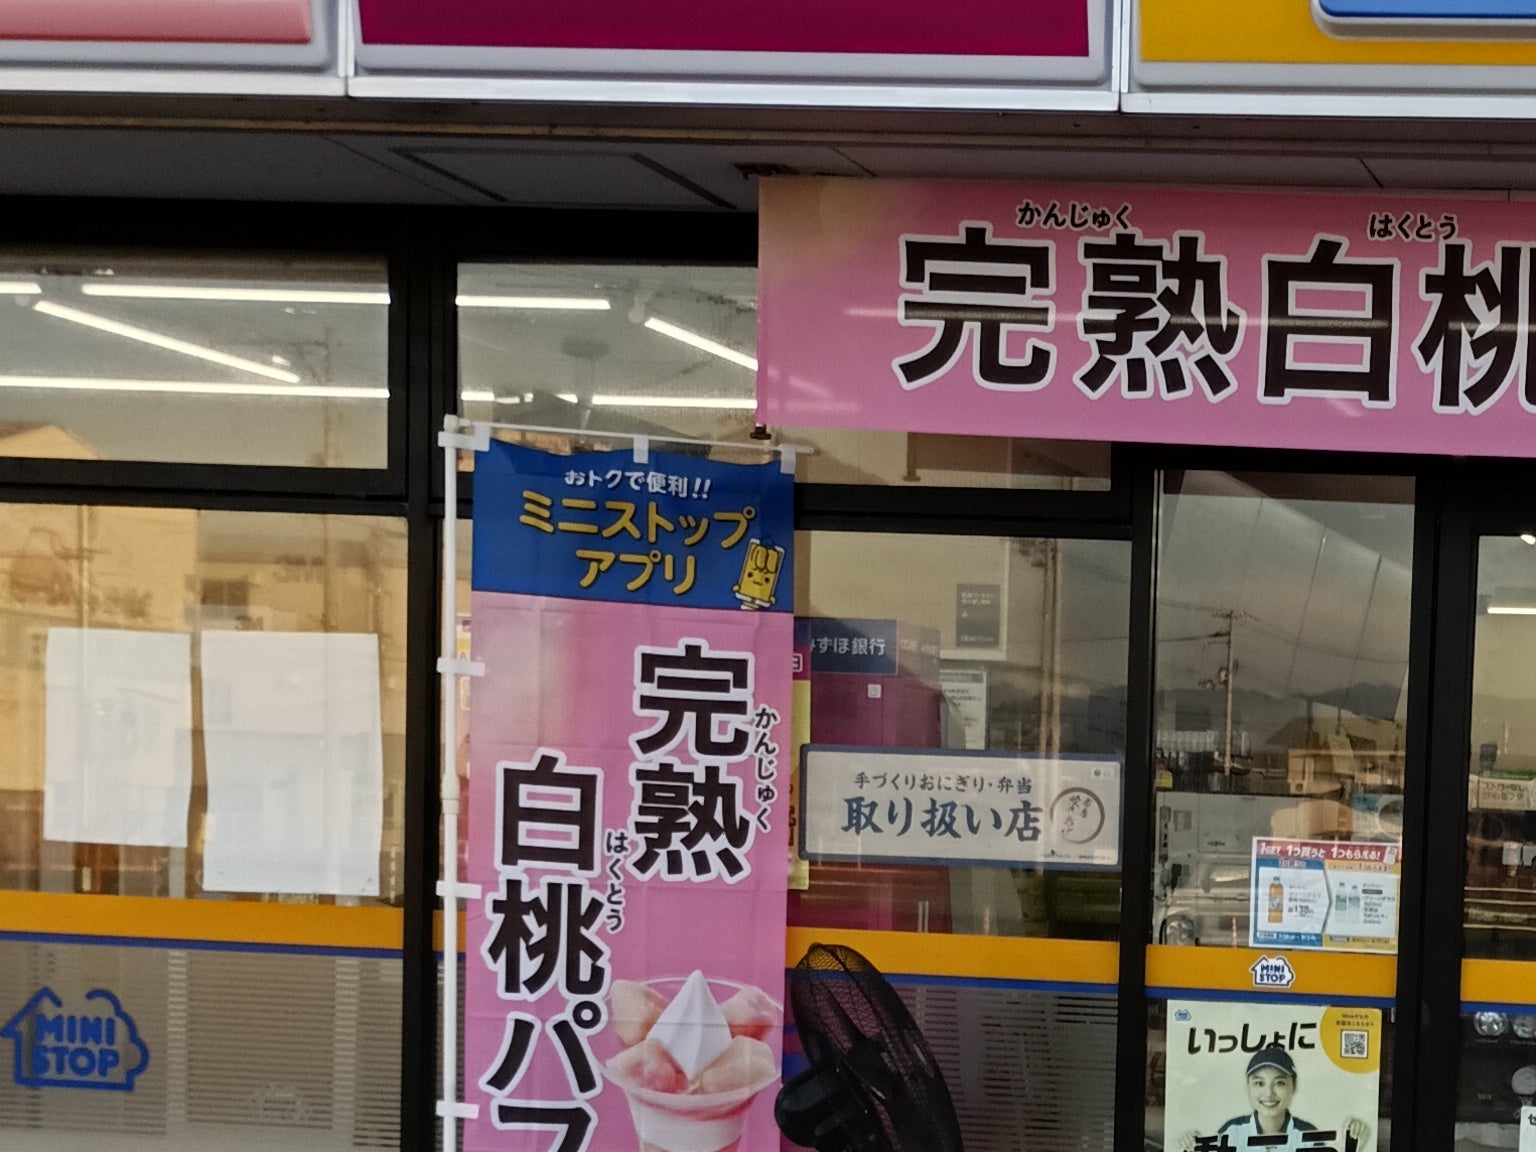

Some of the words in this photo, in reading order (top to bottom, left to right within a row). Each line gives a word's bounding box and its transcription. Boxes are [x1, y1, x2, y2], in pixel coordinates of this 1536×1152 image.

[1018, 201, 1131, 229] かんじゅく
[1369, 213, 1458, 241] はくとう
[519, 489, 755, 548] ミニストップ
[576, 549, 696, 595] アプリ
[633, 644, 750, 878] 完熟
[754, 708, 778, 831] かんじゅく
[841, 796, 1043, 843] 取り扱い店
[606, 831, 626, 931] はくとう
[1259, 973, 1286, 983] STOP
[1260, 964, 1285, 973] MINI
[35, 1015, 115, 1046] MINI
[1188, 1021, 1317, 1055] いっしょに
[33, 1045, 120, 1078] STOP
